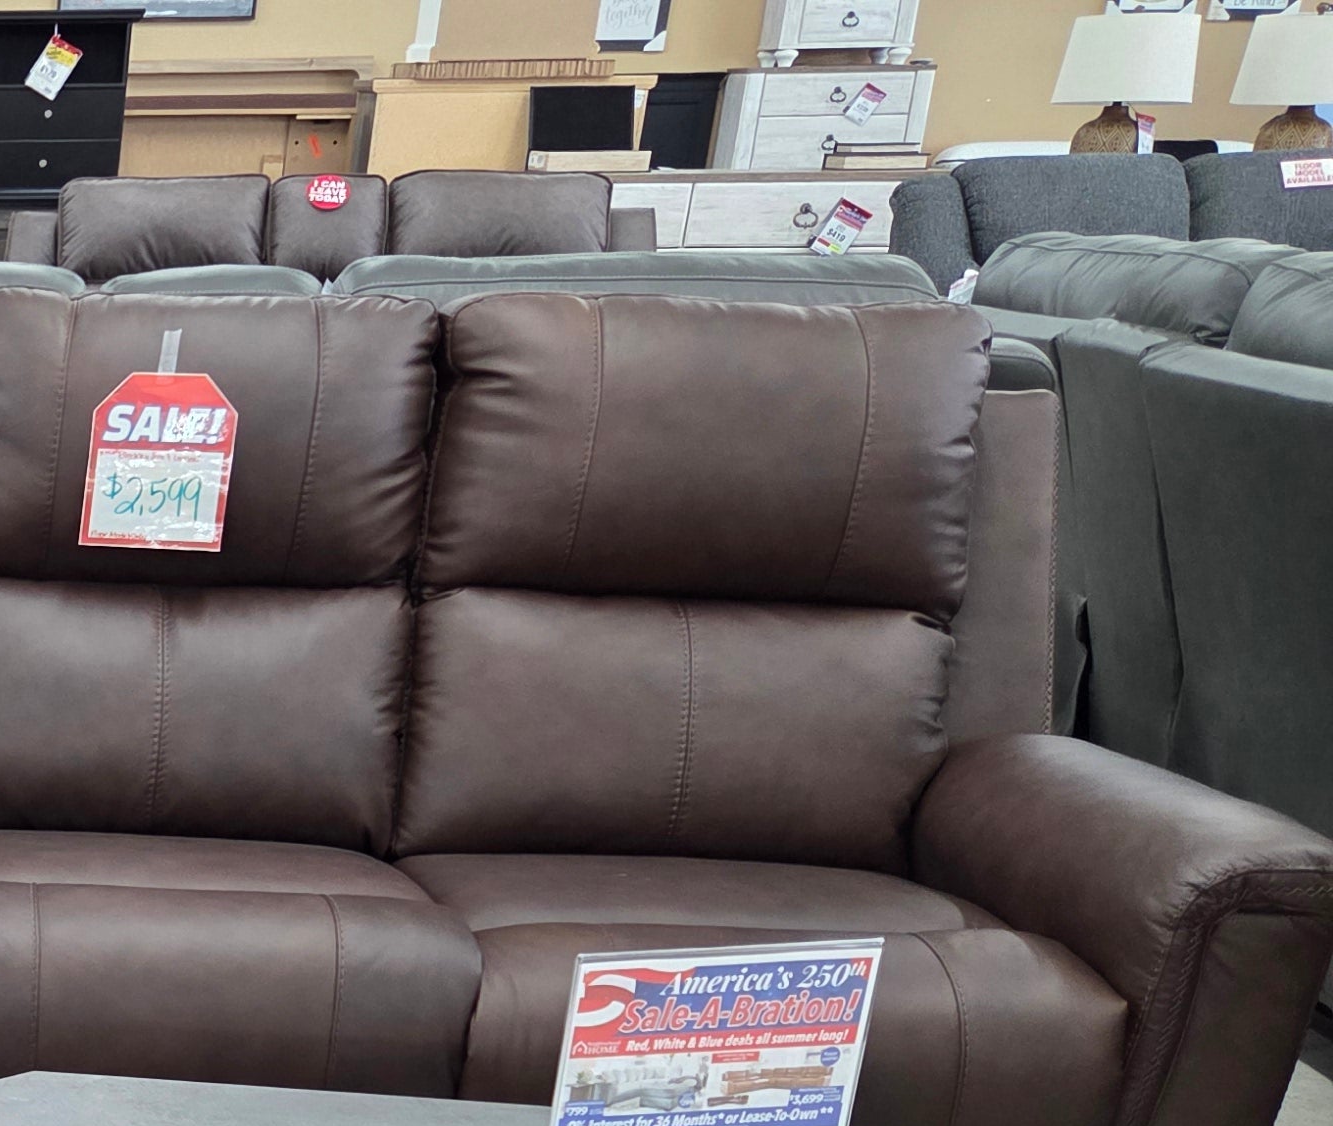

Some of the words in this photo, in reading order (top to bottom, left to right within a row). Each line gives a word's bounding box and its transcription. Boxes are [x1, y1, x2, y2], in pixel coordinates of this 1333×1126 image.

[310, 187, 347, 195] LEAVE
[314, 180, 318, 188] I
[321, 180, 345, 188] CAN
[309, 194, 346, 203] TODAY
[102, 404, 227, 445] SALE!
[102, 472, 202, 521] $2,599
[659, 966, 794, 996] America's
[797, 960, 867, 989] 250th
[618, 988, 862, 1033] Sale-A-Bration!
[625, 1038, 650, 1052] Red,
[653, 1037, 686, 1050] White
[688, 1036, 697, 1049] &
[698, 1035, 724, 1048] Blue
[725, 1034, 754, 1047] deals
[755, 1032, 771, 1045] all
[772, 1032, 818, 1044] summer
[819, 1029, 849, 1044] long!
[724, 1113, 739, 1124] or
